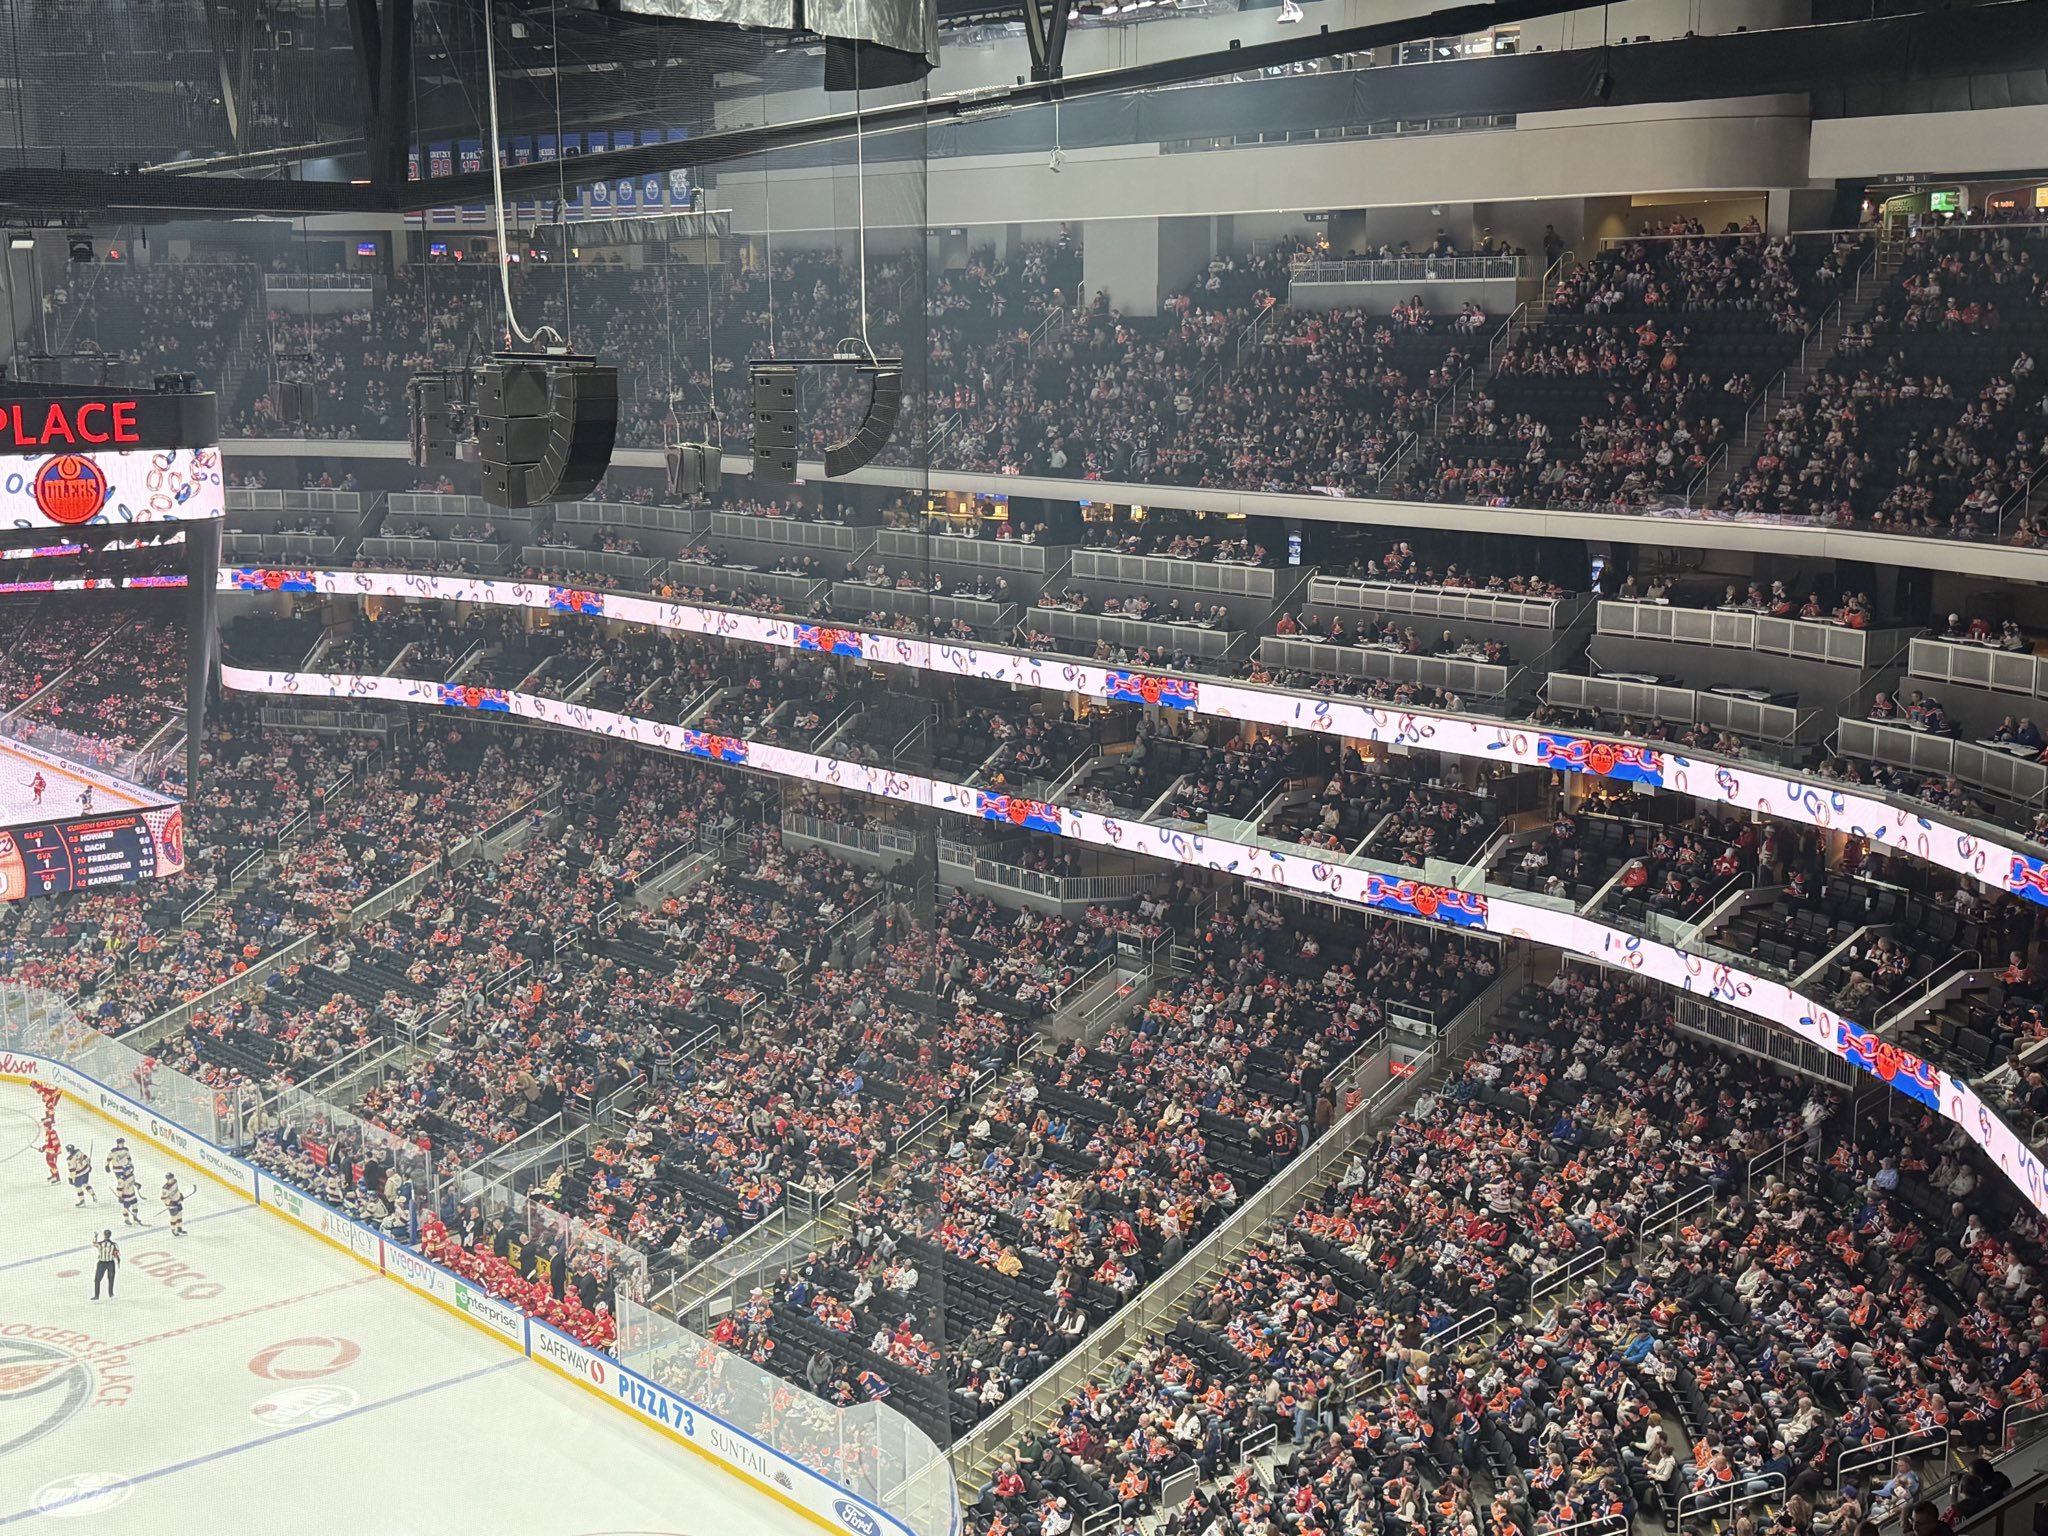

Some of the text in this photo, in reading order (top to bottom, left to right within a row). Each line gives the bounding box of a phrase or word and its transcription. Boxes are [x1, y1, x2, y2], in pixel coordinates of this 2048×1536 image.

[431, 159, 453, 178] 99
[44, 478, 97, 499] OILERS
[35, 838, 41, 848] 1
[80, 830, 114, 842] HOWARD
[84, 842, 106, 852] DACH
[87, 851, 124, 863] FREDERIC
[44, 859, 50, 869] 1
[43, 880, 52, 891] 0
[88, 873, 124, 886] KAPANEN
[330, 1214, 373, 1250] LEGACY
[460, 1290, 517, 1330] enterprise
[540, 1333, 589, 1374] SAFEWAY
[0, 1322, 134, 1407] OGERS PLACE
[619, 1373, 695, 1437] PIZZA 73
[710, 1428, 771, 1479] SUNTAIL
[842, 1503, 873, 1535] Ford
